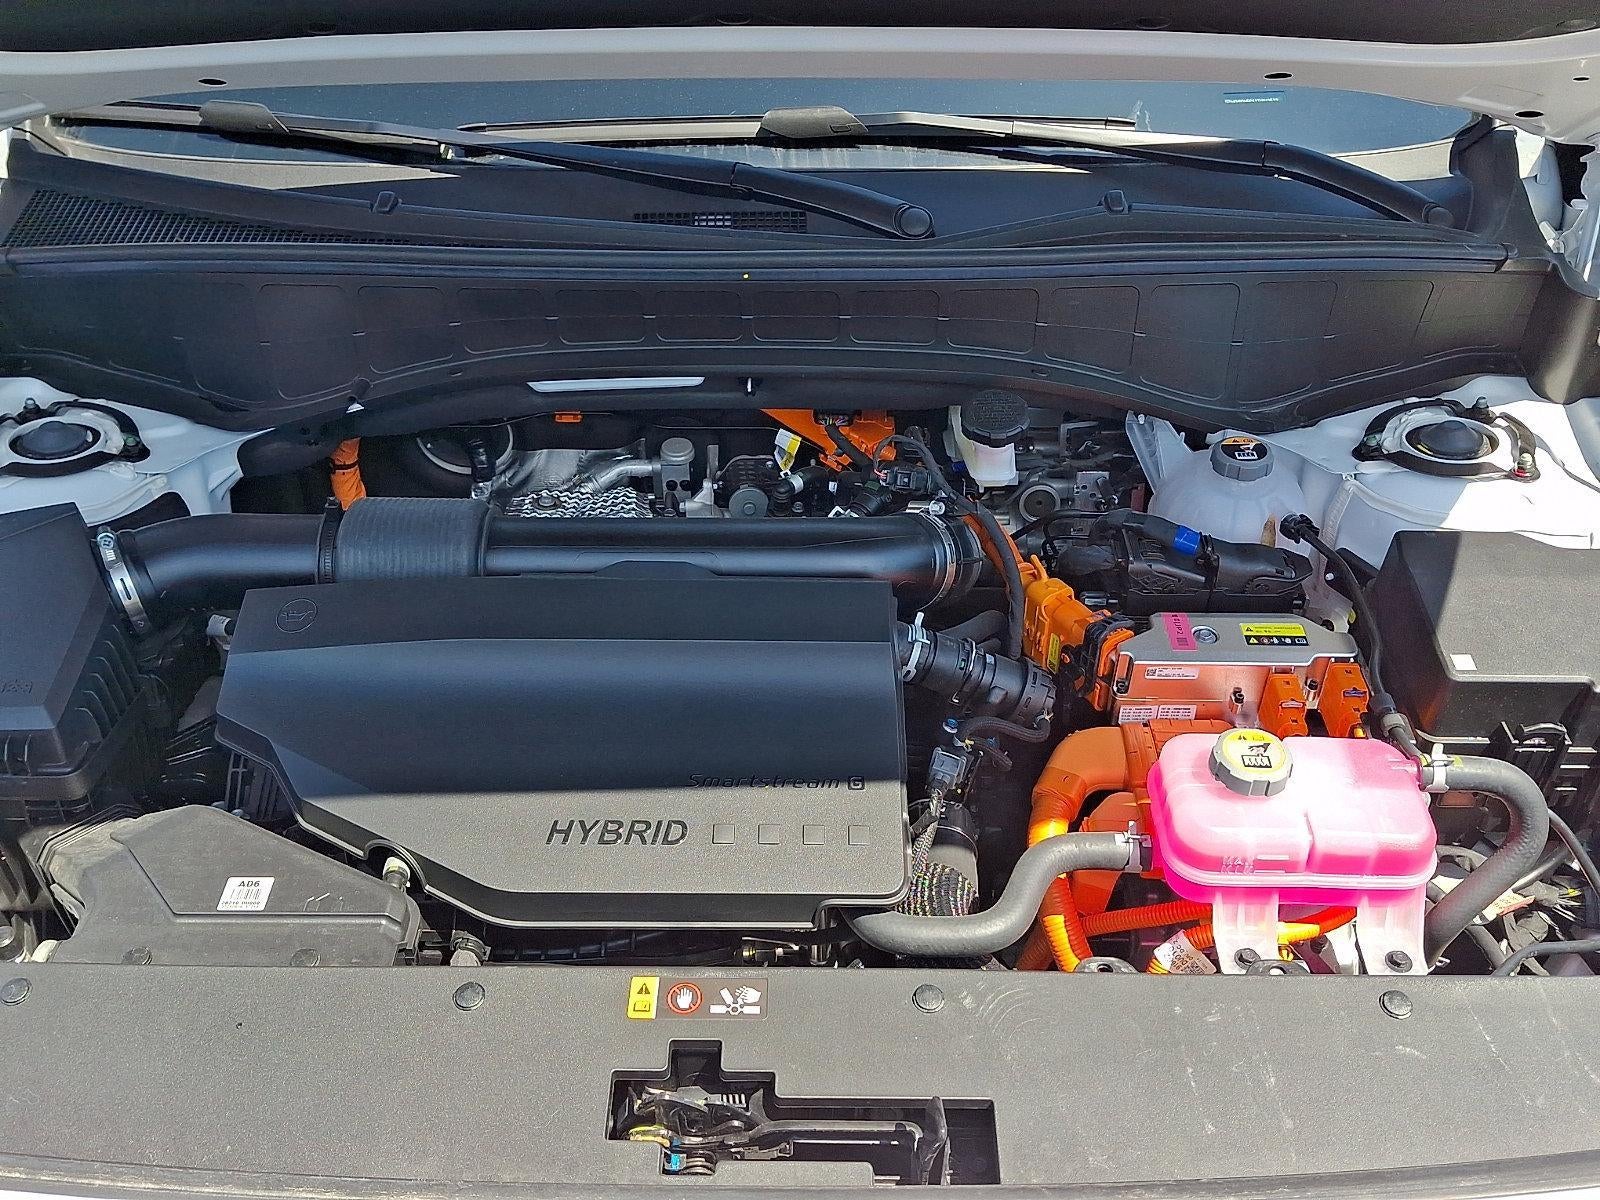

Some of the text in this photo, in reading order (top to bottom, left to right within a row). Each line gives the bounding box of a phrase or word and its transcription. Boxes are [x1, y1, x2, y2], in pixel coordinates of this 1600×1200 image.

[687, 773, 840, 789] Smartstream
[546, 819, 688, 846] HYBRID
[238, 880, 261, 888] AD6
